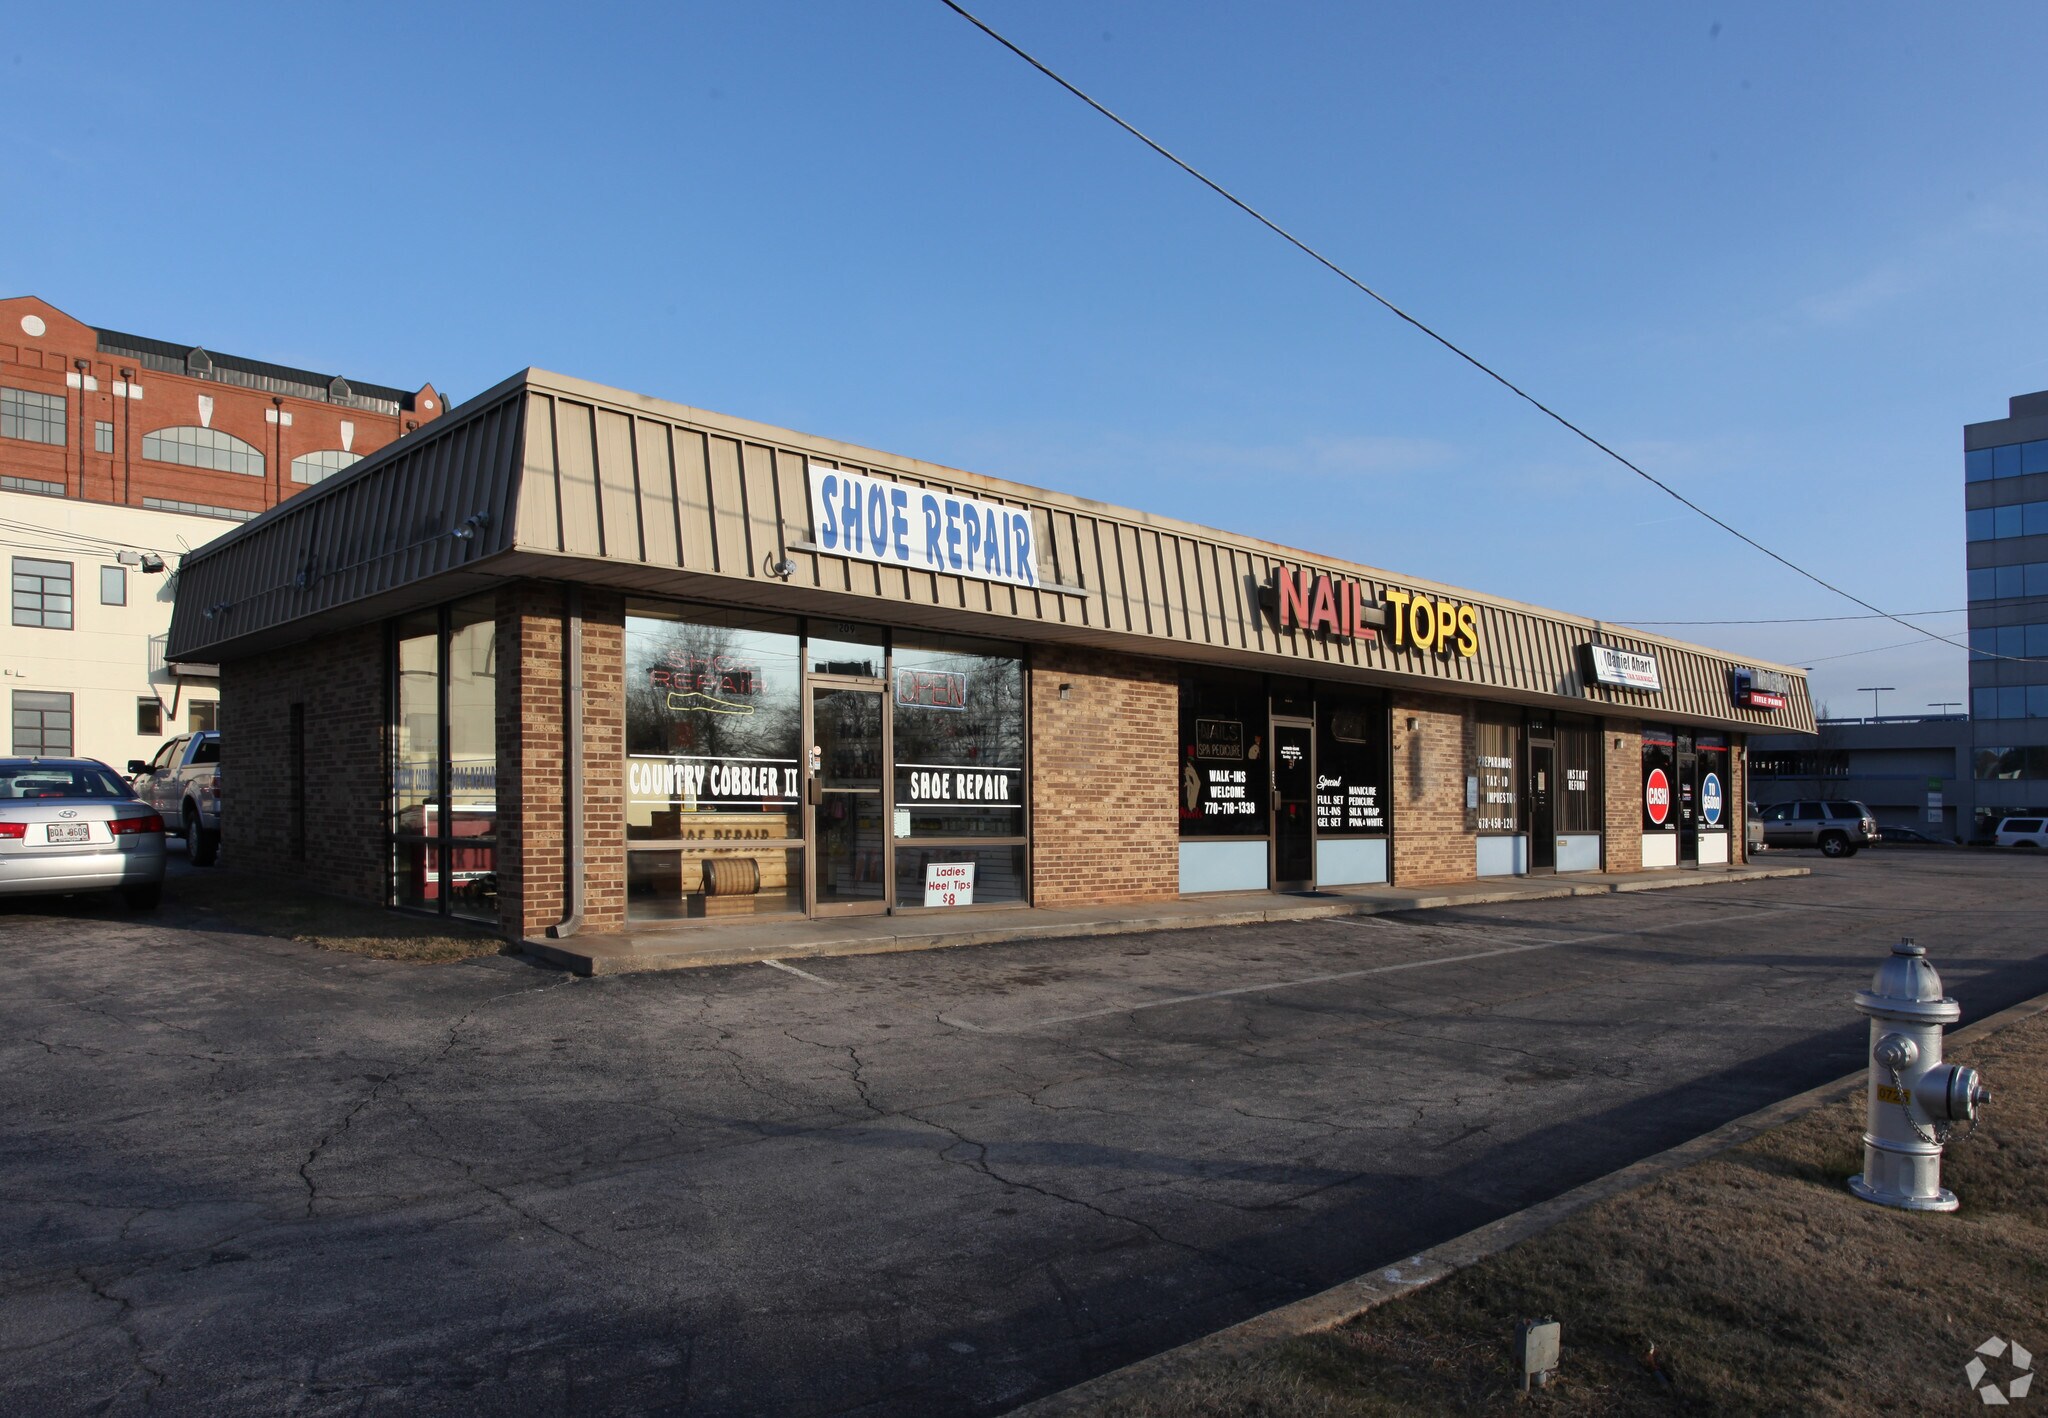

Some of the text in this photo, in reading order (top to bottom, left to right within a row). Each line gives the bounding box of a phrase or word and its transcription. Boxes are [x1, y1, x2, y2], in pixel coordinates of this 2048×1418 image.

[821, 474, 1034, 587] SHOE REPAIR
[1276, 566, 1478, 658] NAIL TOPS
[838, 623, 855, 634] 209
[1606, 651, 1652, 674] Daniel Ahart
[899, 671, 965, 706] OPEN
[1198, 743, 1211, 756] SPA
[1477, 755, 1512, 769] PREPARAMOS
[629, 762, 798, 797] COUNTRY COBBLER II
[1209, 769, 1247, 783] WALK-INS
[1567, 769, 1589, 781] INSTANT
[910, 771, 1009, 800] SHOE REPAIR
[1316, 775, 1341, 790] Special
[1568, 780, 1586, 791] REFUND
[1708, 782, 1716, 796] TO
[1210, 785, 1246, 799] WELCOME
[1348, 786, 1377, 796] MANICURE
[1648, 787, 1667, 805] CASH
[1317, 795, 1344, 805] FULL SET
[1348, 797, 1375, 806] PEDICURE
[1204, 801, 1256, 815] 770-718-1338
[1317, 806, 1342, 816] FILL-INS
[1348, 807, 1380, 816] SILK WRAP
[1317, 817, 1342, 827] GEL SET
[1366, 817, 1384, 827] WHITE
[936, 867, 965, 877] Ladies
[928, 880, 971, 891] Heel Tips
[943, 893, 956, 906] $8
